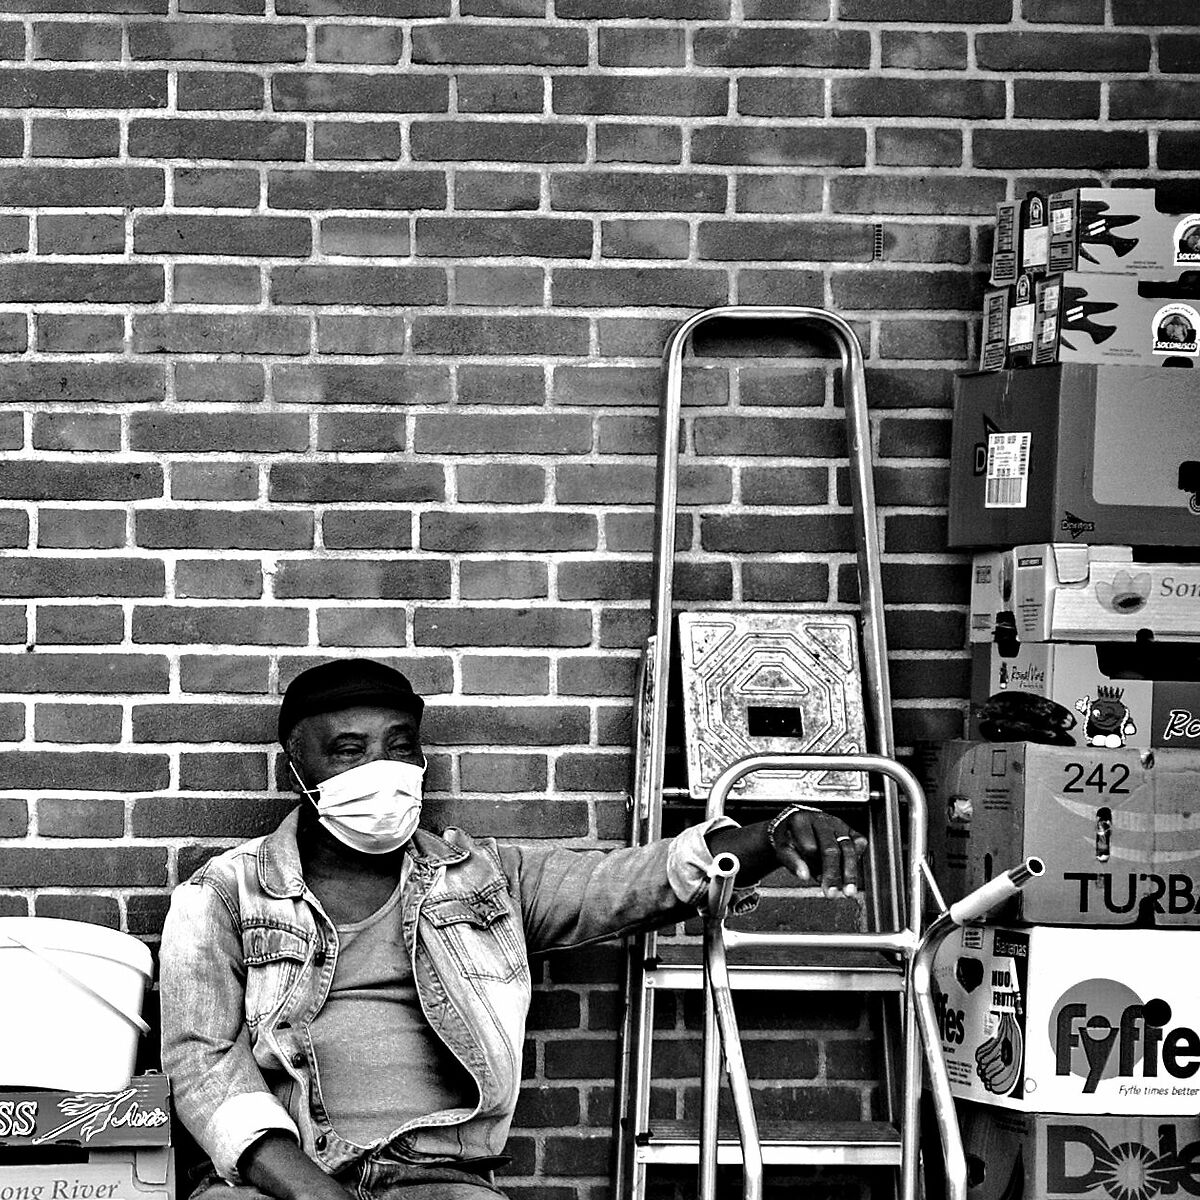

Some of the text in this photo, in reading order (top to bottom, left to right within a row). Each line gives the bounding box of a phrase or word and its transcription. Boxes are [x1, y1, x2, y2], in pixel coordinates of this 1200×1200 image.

[1063, 763, 1130, 794] 242
[1064, 873, 1200, 914] TURB
[1144, 1087, 1169, 1096] times
[51, 1179, 118, 1200] River
